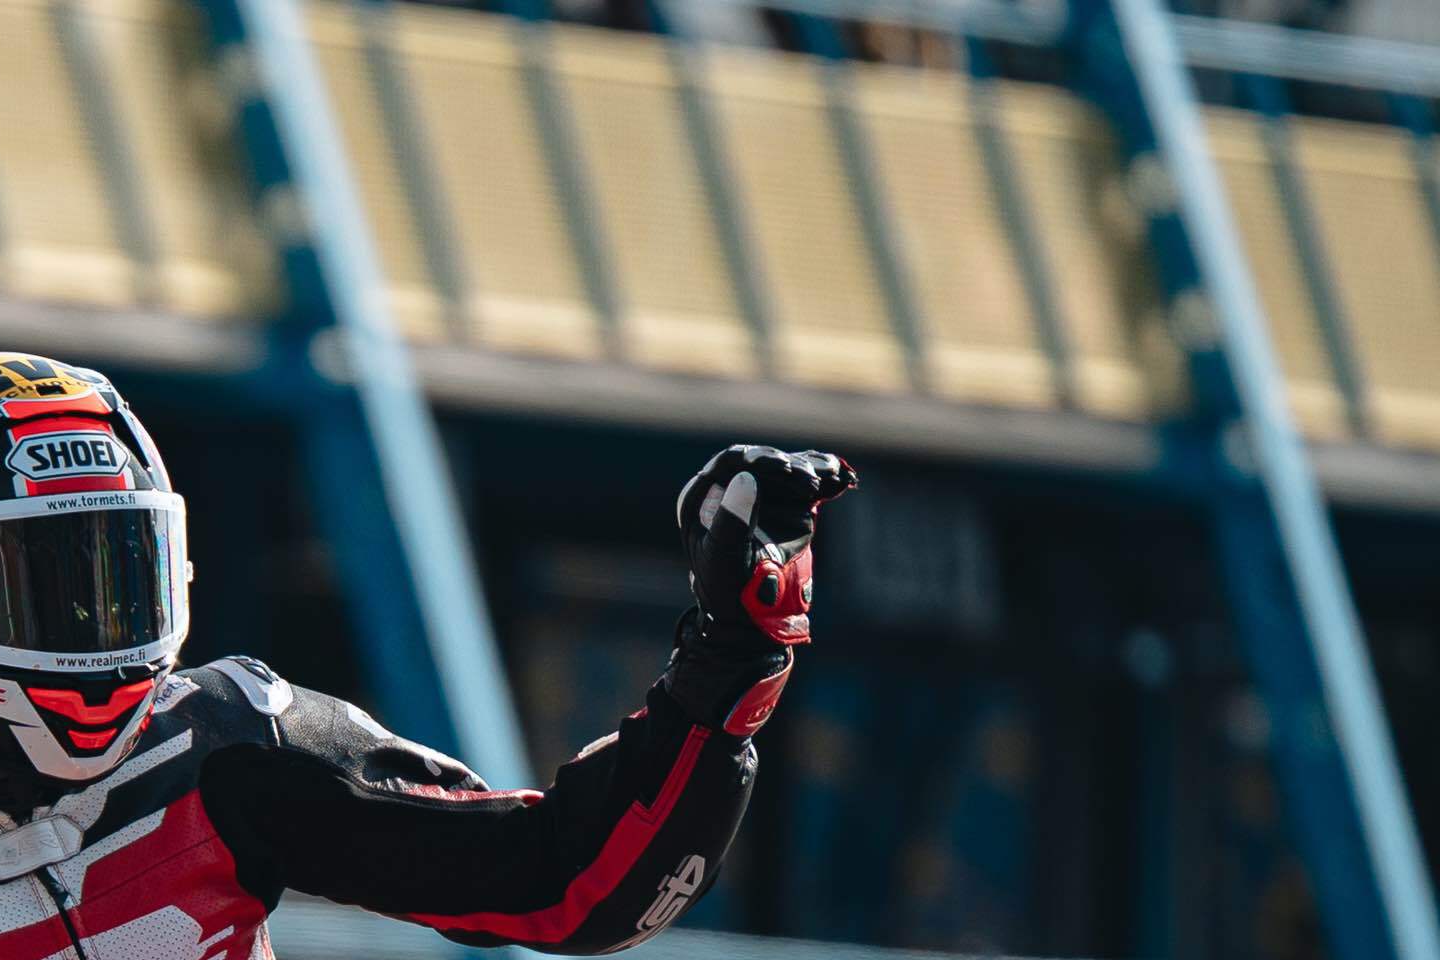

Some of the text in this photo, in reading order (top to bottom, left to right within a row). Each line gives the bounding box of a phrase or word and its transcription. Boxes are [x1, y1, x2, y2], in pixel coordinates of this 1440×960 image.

[26, 440, 117, 472] SHOEI
[46, 493, 136, 511] www.tormets.fi
[55, 652, 146, 668] www.realmec.fi
